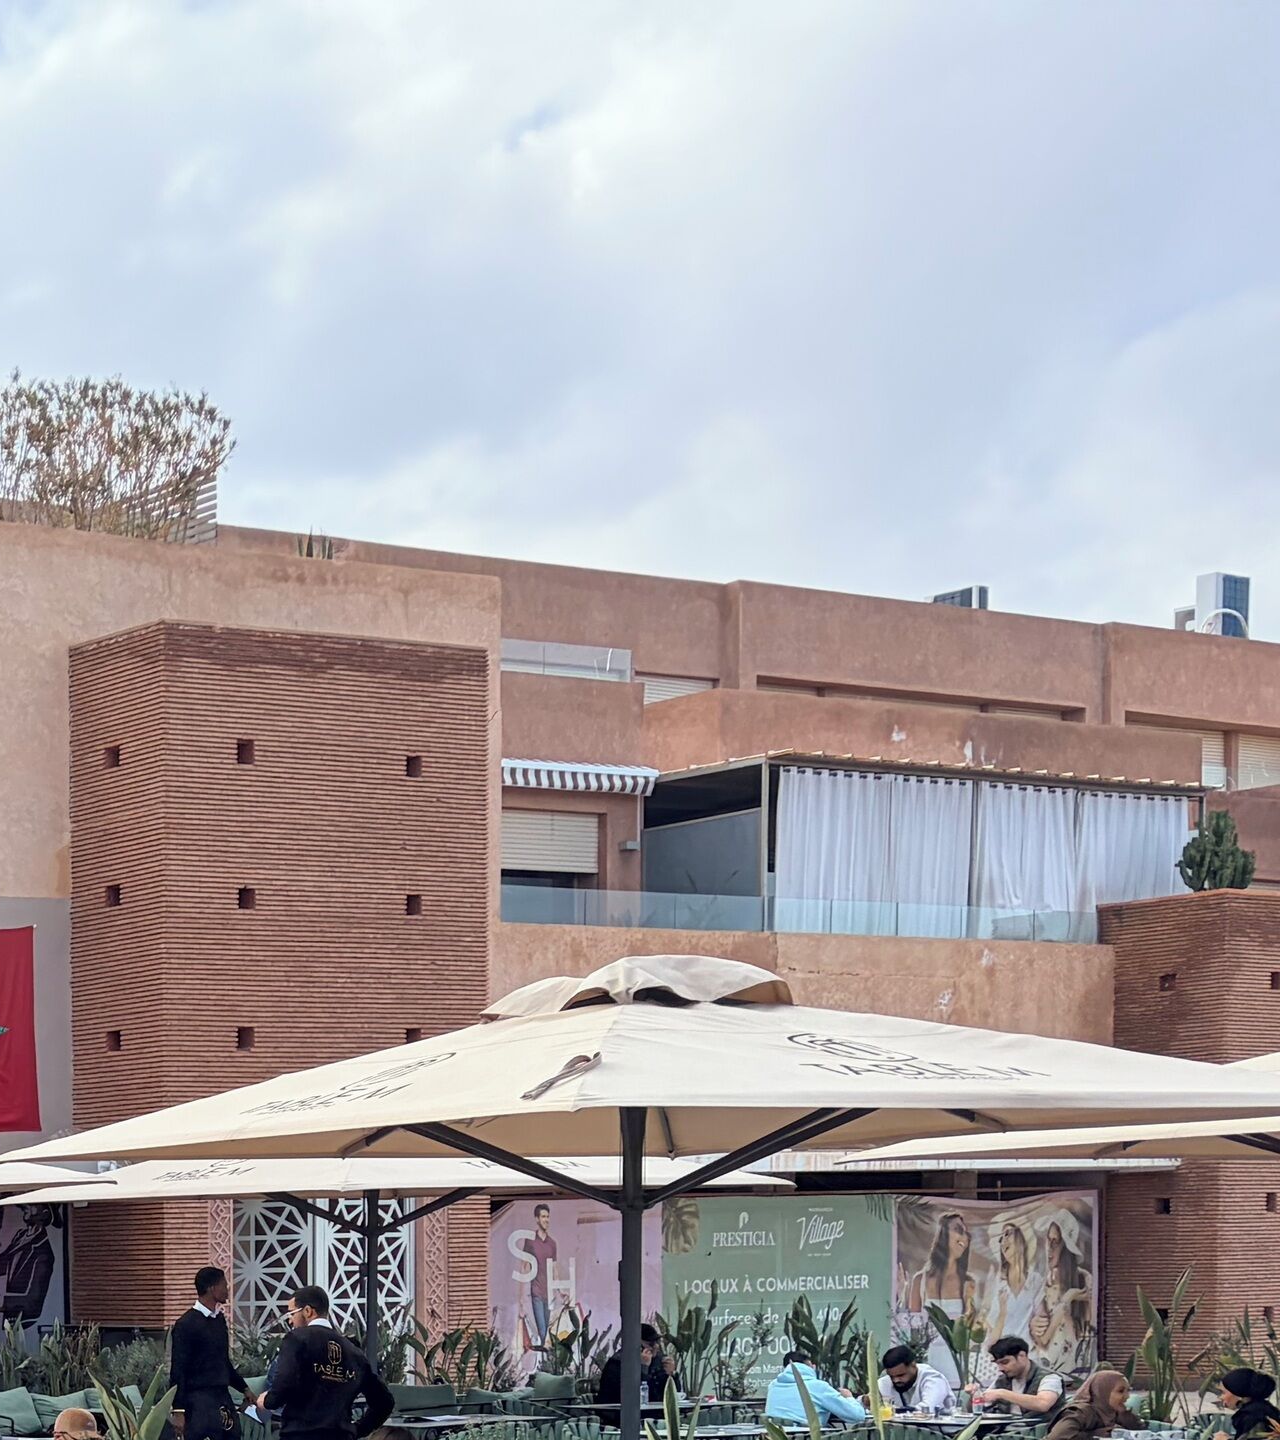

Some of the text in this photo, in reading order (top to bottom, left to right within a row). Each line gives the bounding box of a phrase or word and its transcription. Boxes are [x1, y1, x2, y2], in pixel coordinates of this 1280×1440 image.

[713, 1231, 775, 1247] PRESTIGIA
[797, 1215, 844, 1250] Village
[684, 1274, 869, 1295] LOCUX À COMMERCIALISER
